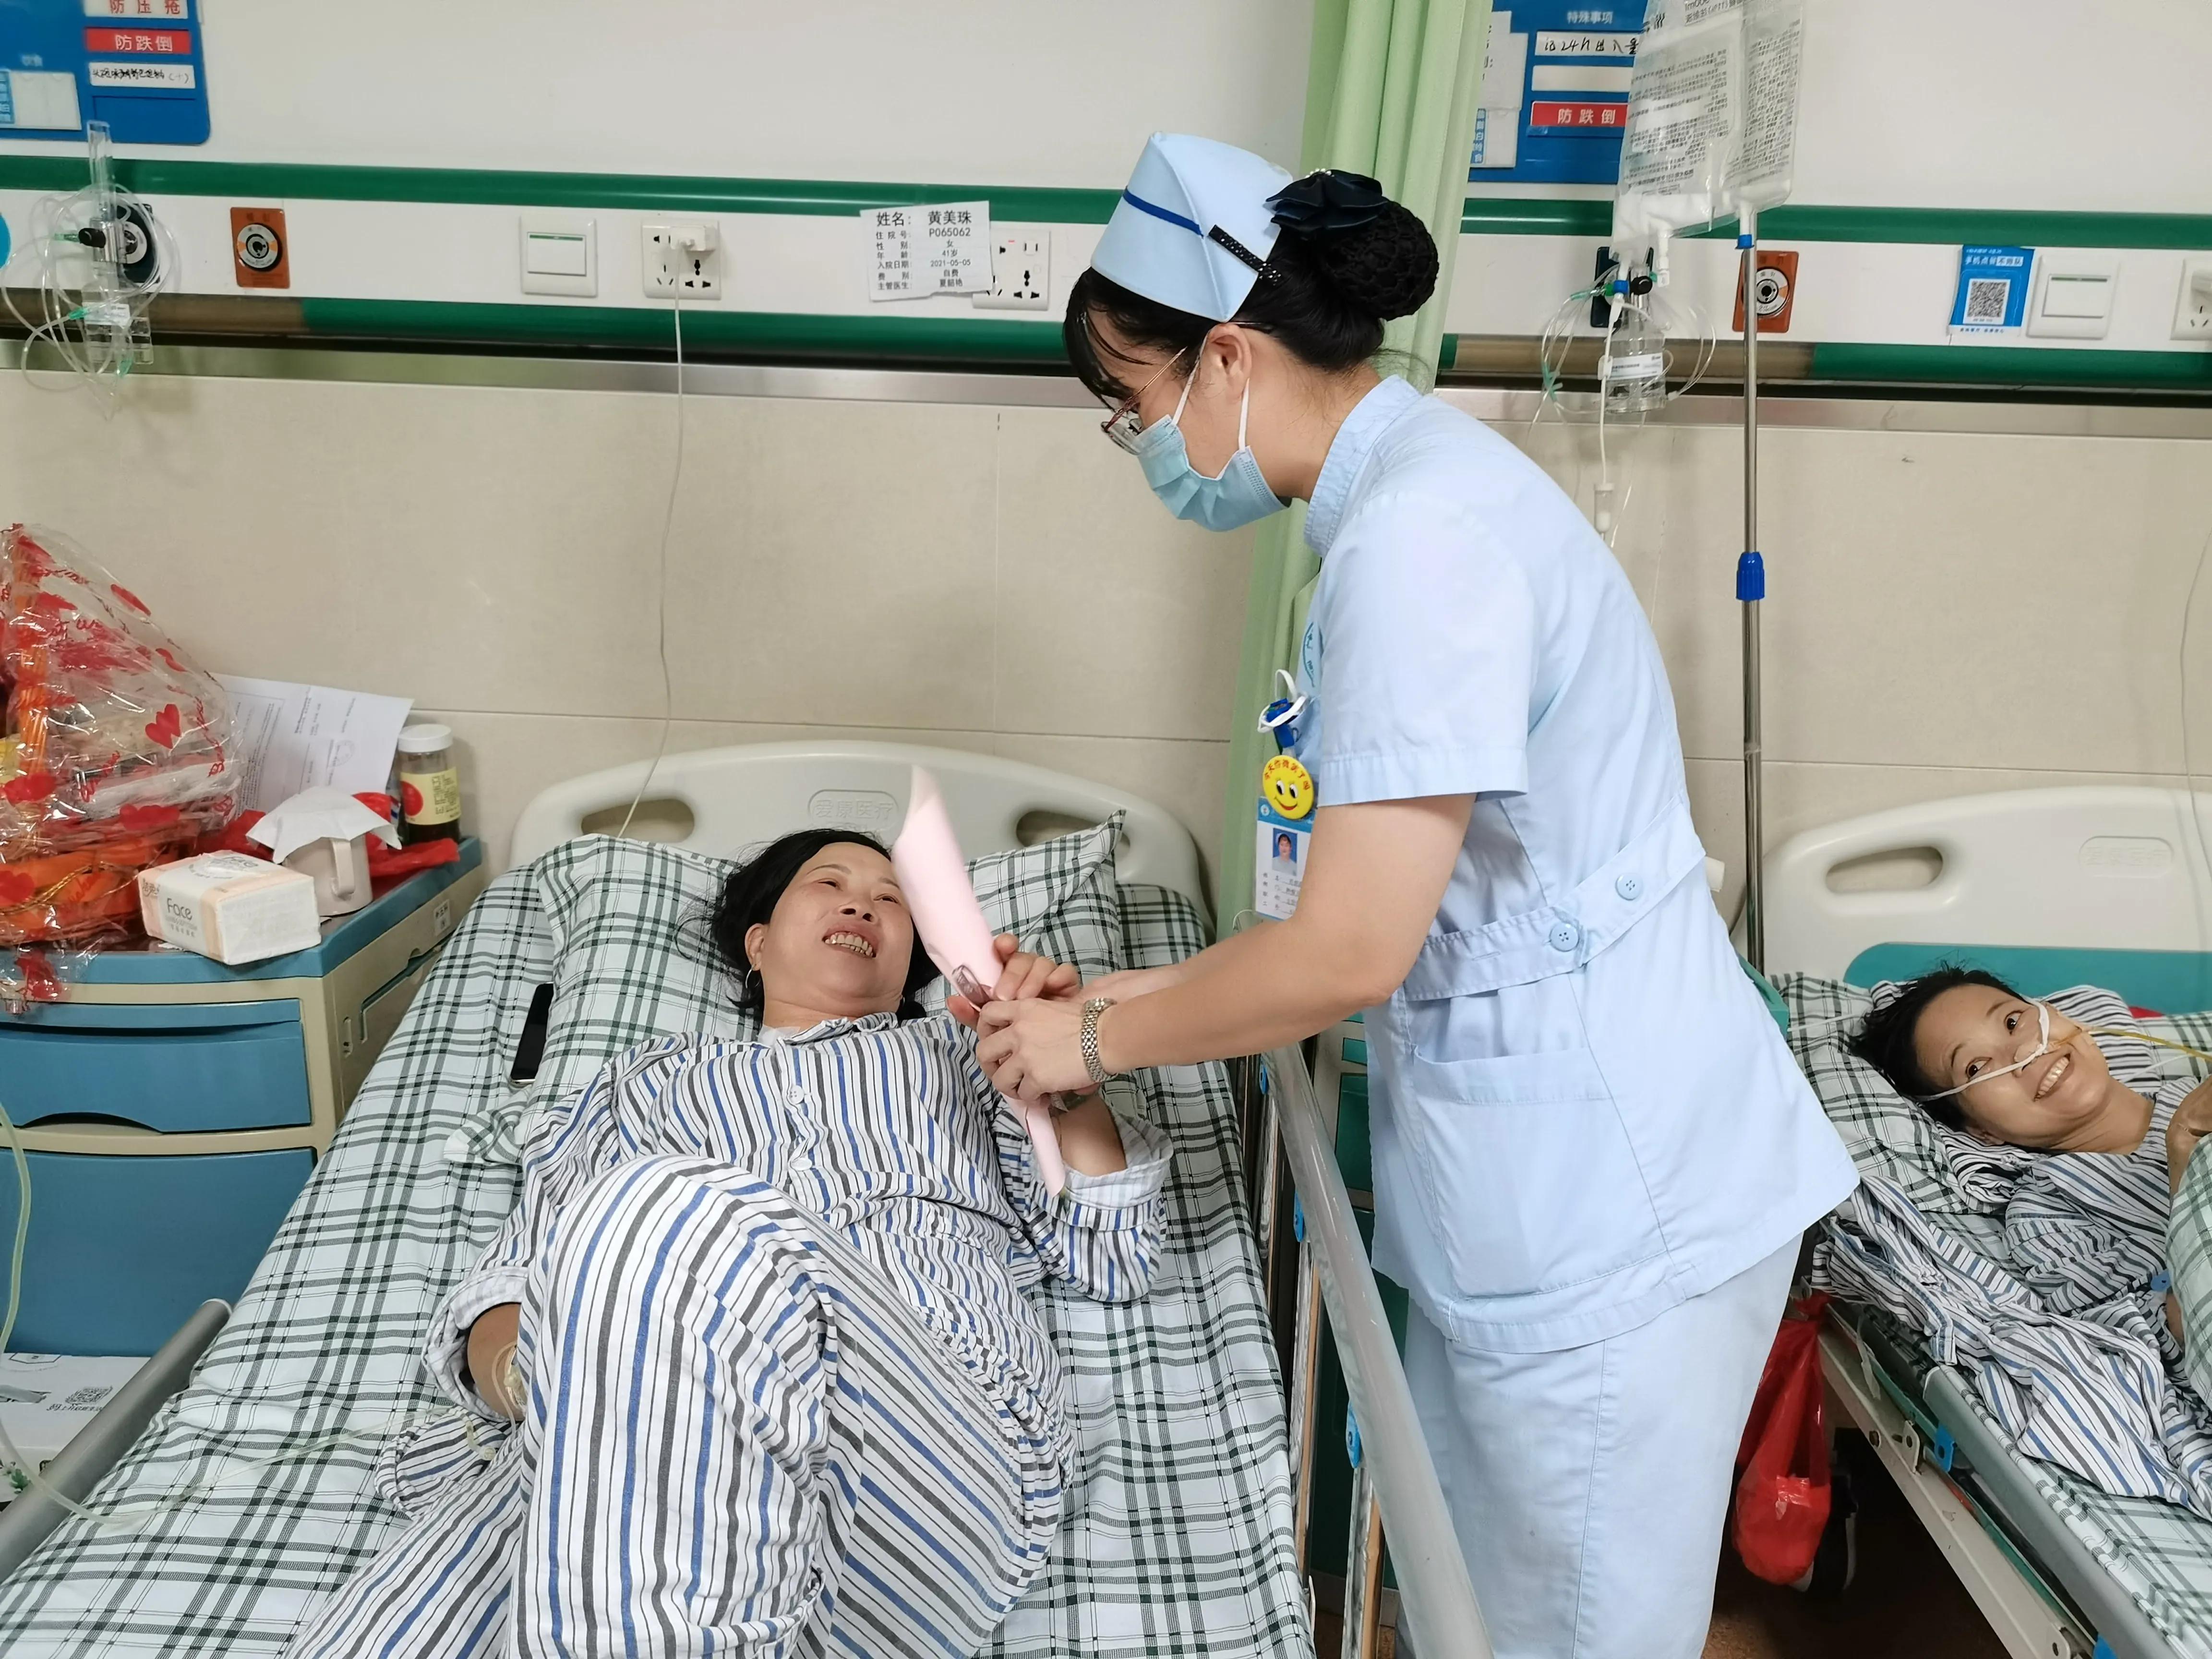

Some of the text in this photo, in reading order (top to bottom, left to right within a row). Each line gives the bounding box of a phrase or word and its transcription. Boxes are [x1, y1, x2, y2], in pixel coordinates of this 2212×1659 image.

[1567, 11, 1613, 24] 特殊事项
[115, 35, 173, 52] 防跌倒
[1557, 109, 1616, 124] 防跌倒
[927, 210, 972, 226] 黄美珠
[929, 227, 971, 237] P065062
[947, 239, 954, 248] 女
[942, 248, 958, 257] 41岁
[930, 259, 971, 267] 2021-05-05
[815, 799, 894, 820] 爱康医疗
[167, 897, 193, 921] Face
